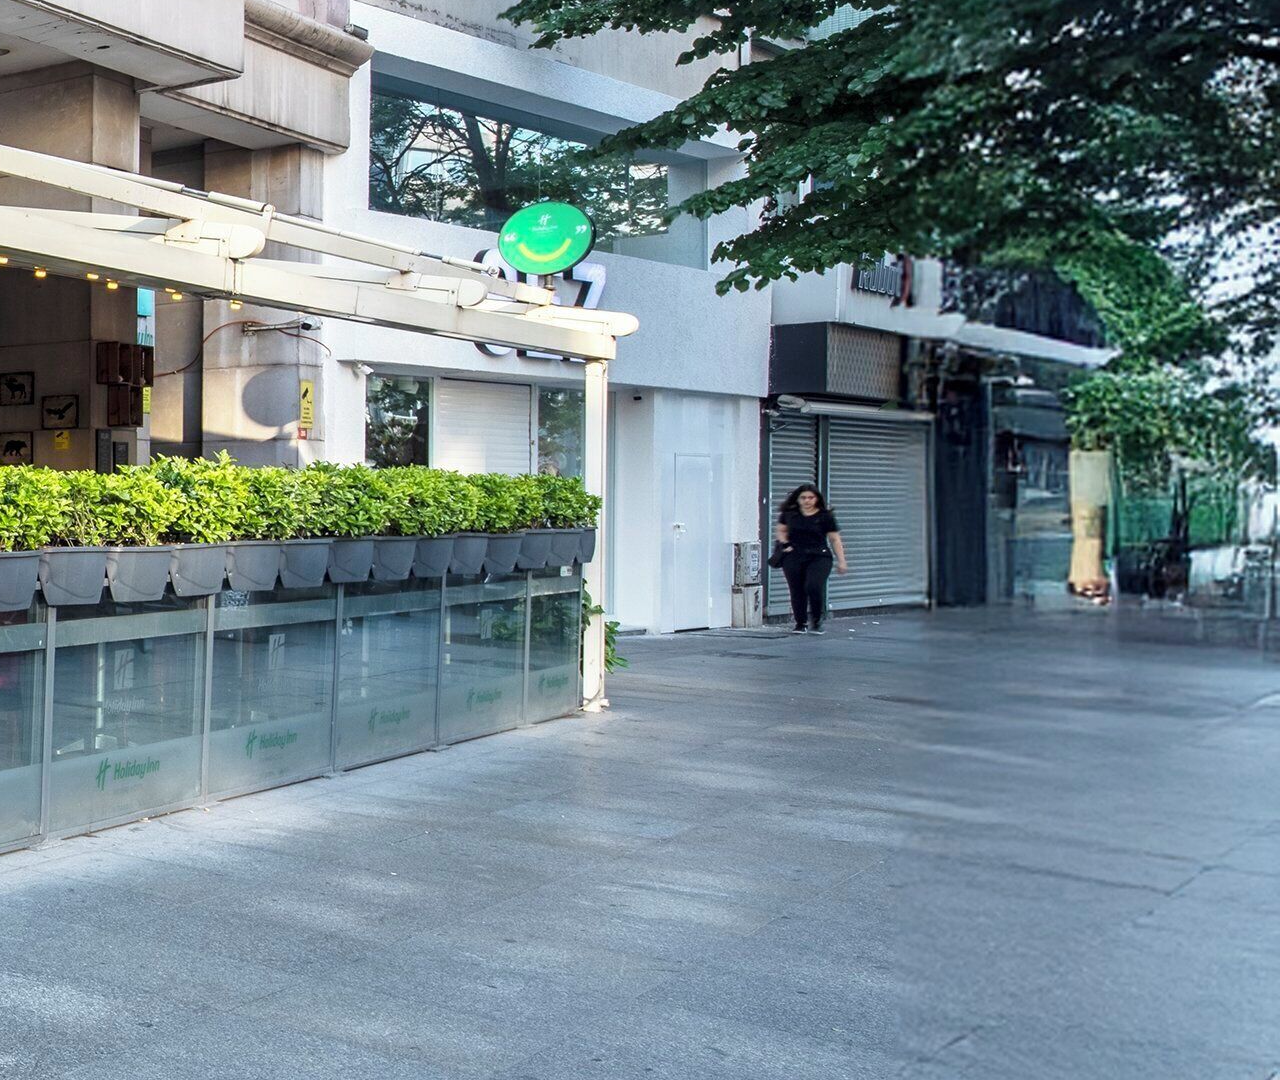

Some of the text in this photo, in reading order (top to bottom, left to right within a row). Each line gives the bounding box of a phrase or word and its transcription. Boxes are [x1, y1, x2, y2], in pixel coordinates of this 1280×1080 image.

[259, 731, 286, 751] Holiday
[286, 728, 298, 746] Inn
[113, 759, 147, 781] Holiday
[146, 756, 161, 776] Inn
